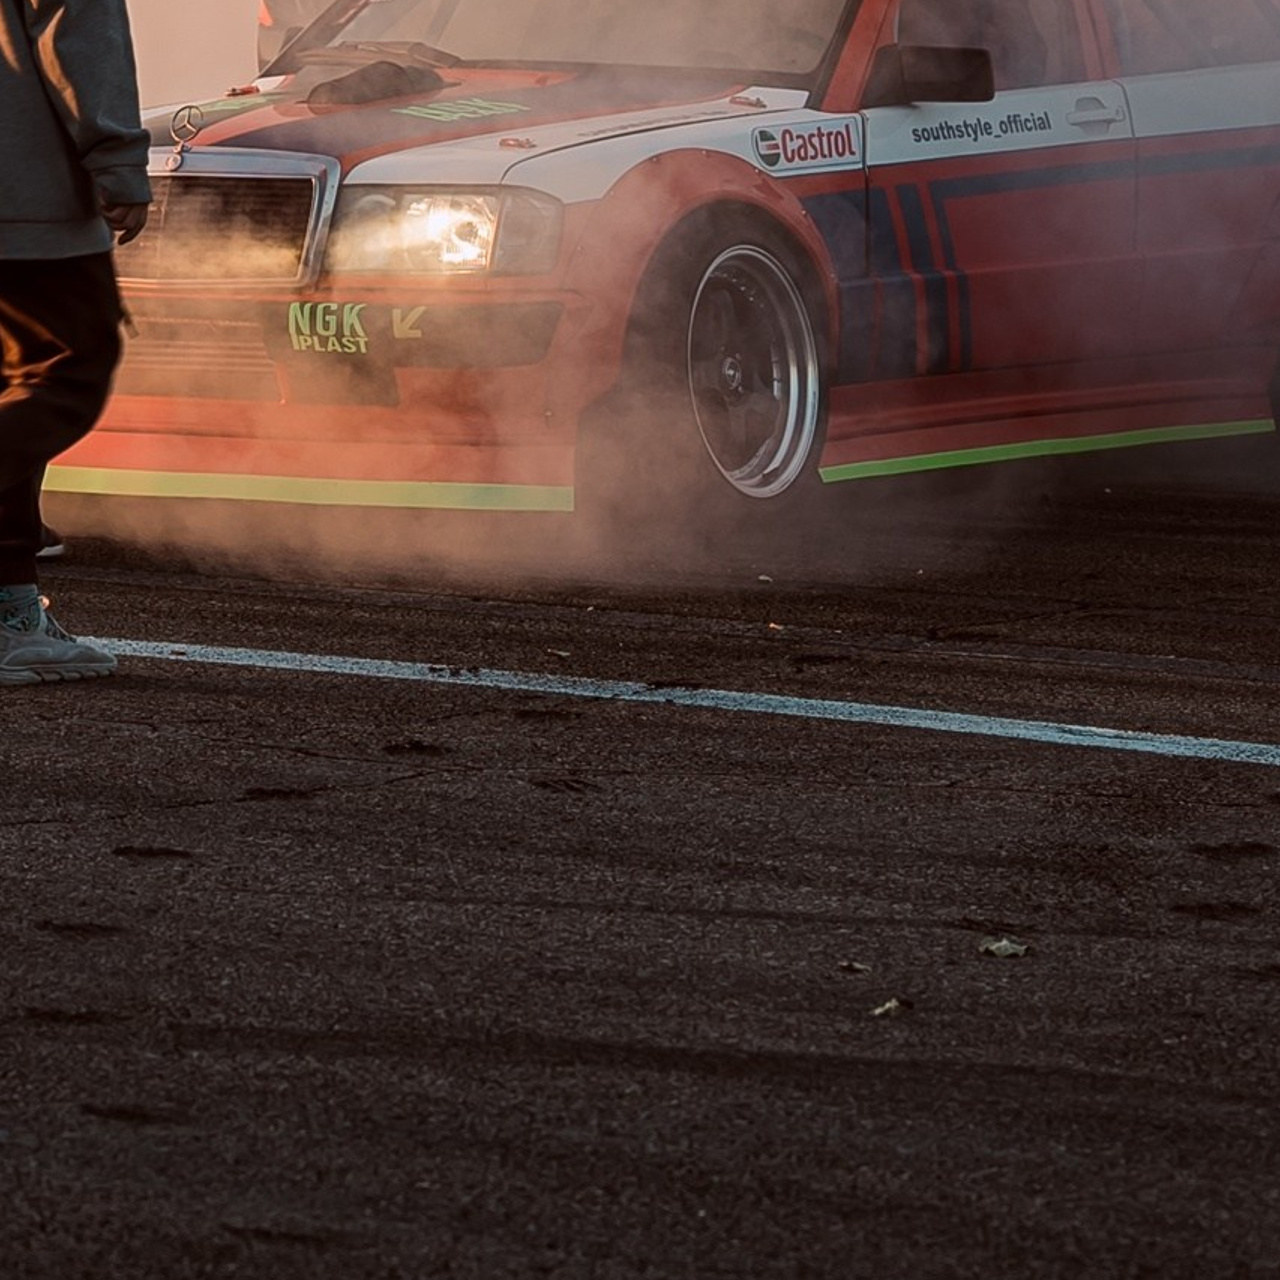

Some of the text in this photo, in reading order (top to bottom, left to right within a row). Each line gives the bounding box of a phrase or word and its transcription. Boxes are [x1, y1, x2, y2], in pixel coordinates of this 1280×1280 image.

[780, 123, 856, 163] Castrol
[911, 111, 1052, 143] southstyle_official
[288, 302, 368, 337] NGK
[298, 334, 369, 354] PLAST
